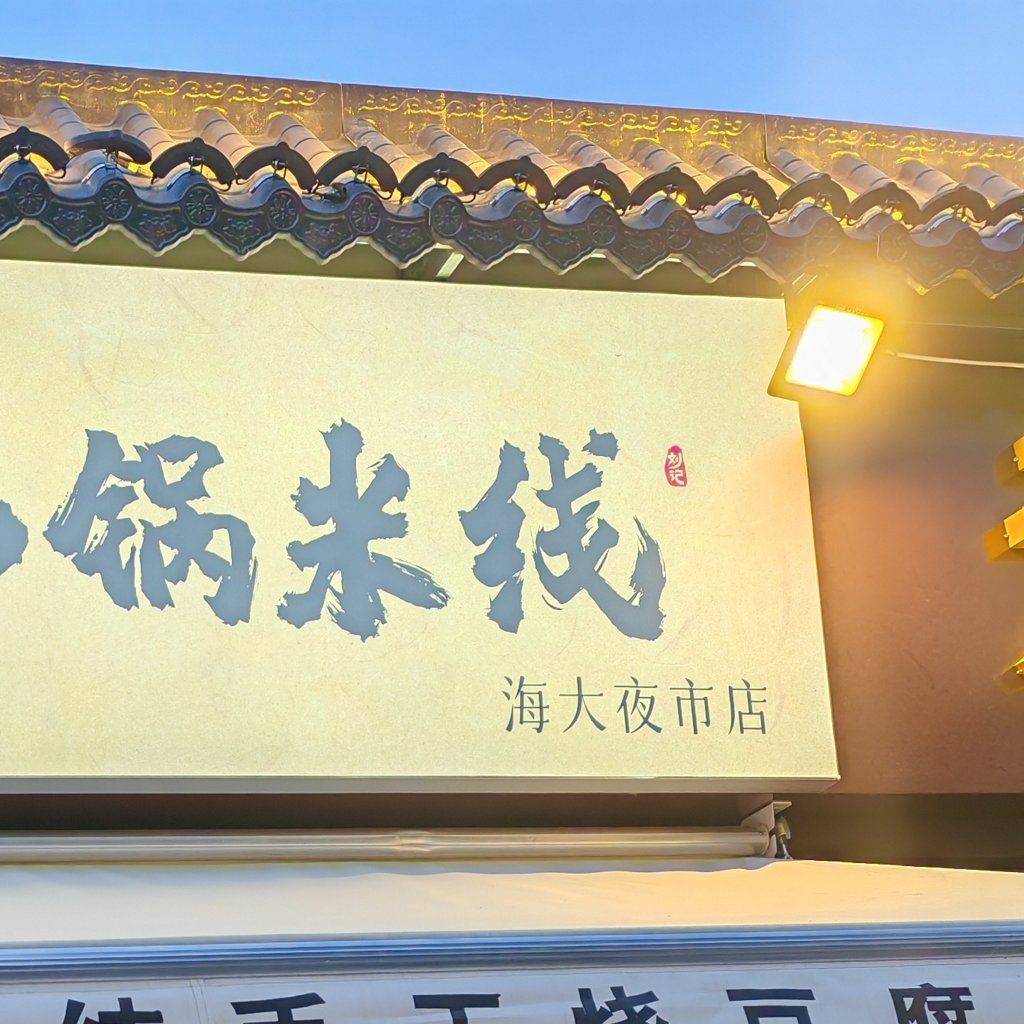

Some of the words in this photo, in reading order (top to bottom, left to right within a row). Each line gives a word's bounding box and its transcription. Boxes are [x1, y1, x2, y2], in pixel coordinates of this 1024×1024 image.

[501, 675, 768, 735] 海大夜市店
